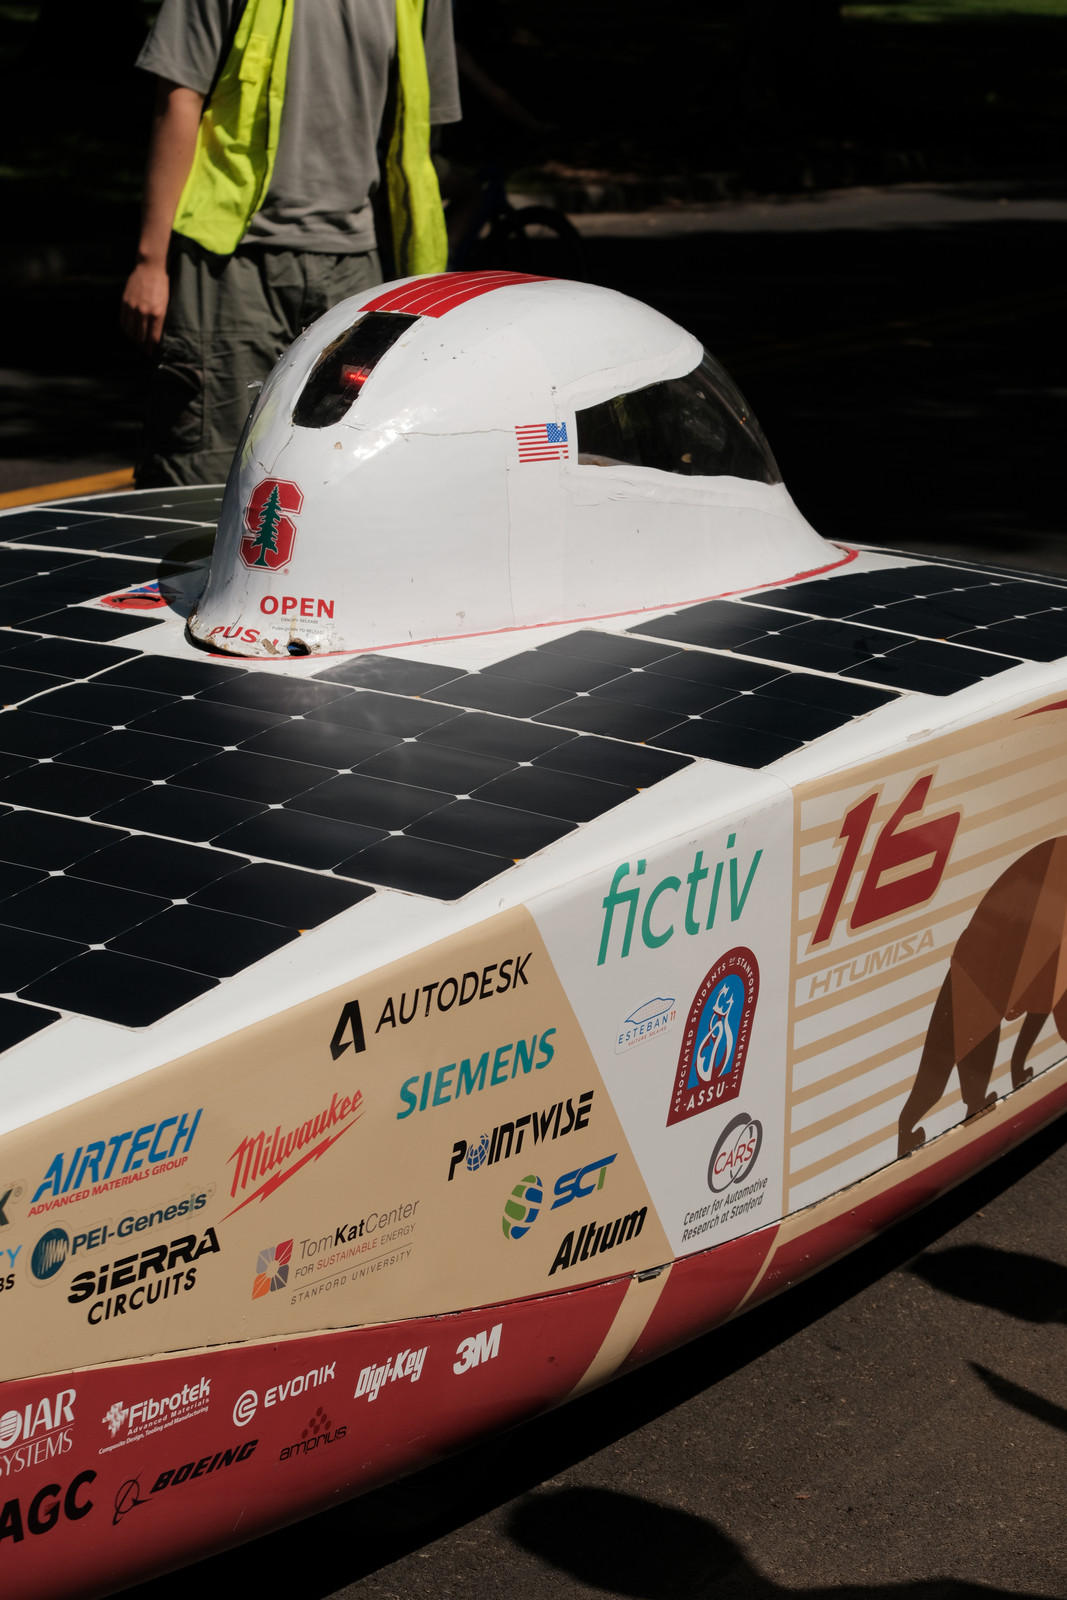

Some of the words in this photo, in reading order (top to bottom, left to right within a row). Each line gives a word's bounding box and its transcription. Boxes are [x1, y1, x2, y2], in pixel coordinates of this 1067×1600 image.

[260, 595, 334, 619] OPEN
[811, 774, 961, 946] 16
[597, 832, 763, 966] fictiv
[375, 952, 533, 1033] AUTODESK
[691, 962, 726, 1023] STUDENTS
[736, 957, 754, 1004] STANFORD
[396, 1027, 557, 1120] SIEMENS
[30, 1108, 203, 1204] AIRTECH
[226, 1089, 363, 1199] Milwaukee
[714, 1138, 756, 1175] CARS
[27, 1189, 90, 1218] ADVANCED
[92, 1169, 150, 1197] MATERIALS
[152, 1156, 188, 1176] GROUP
[550, 1152, 618, 1211] SCT
[683, 1206, 711, 1227] Center
[711, 1198, 724, 1216] for
[724, 1177, 768, 1207] Automotive
[71, 1193, 207, 1255] PEI-Genesis
[681, 1215, 720, 1243] Research
[720, 1213, 729, 1224] at
[730, 1192, 765, 1219] Stanford
[291, 1275, 347, 1305] STANFORD
[352, 1249, 412, 1281] UNIVERSITY
[294, 1263, 315, 1279] FOR
[316, 1238, 378, 1271] SUSTAINABLE
[380, 1222, 416, 1245] ENERGY
[87, 1267, 198, 1325] CIRCUITS
[354, 1346, 427, 1402] Digi-Key
[453, 1323, 503, 1375] 3M
[127, 1415, 168, 1436] Advanced
[170, 1398, 210, 1418] Materials
[128, 1376, 212, 1428] Fibrotek
[98, 1440, 126, 1455] Composite
[150, 1439, 259, 1494] BOEING
[0, 1469, 98, 1544] AGC
